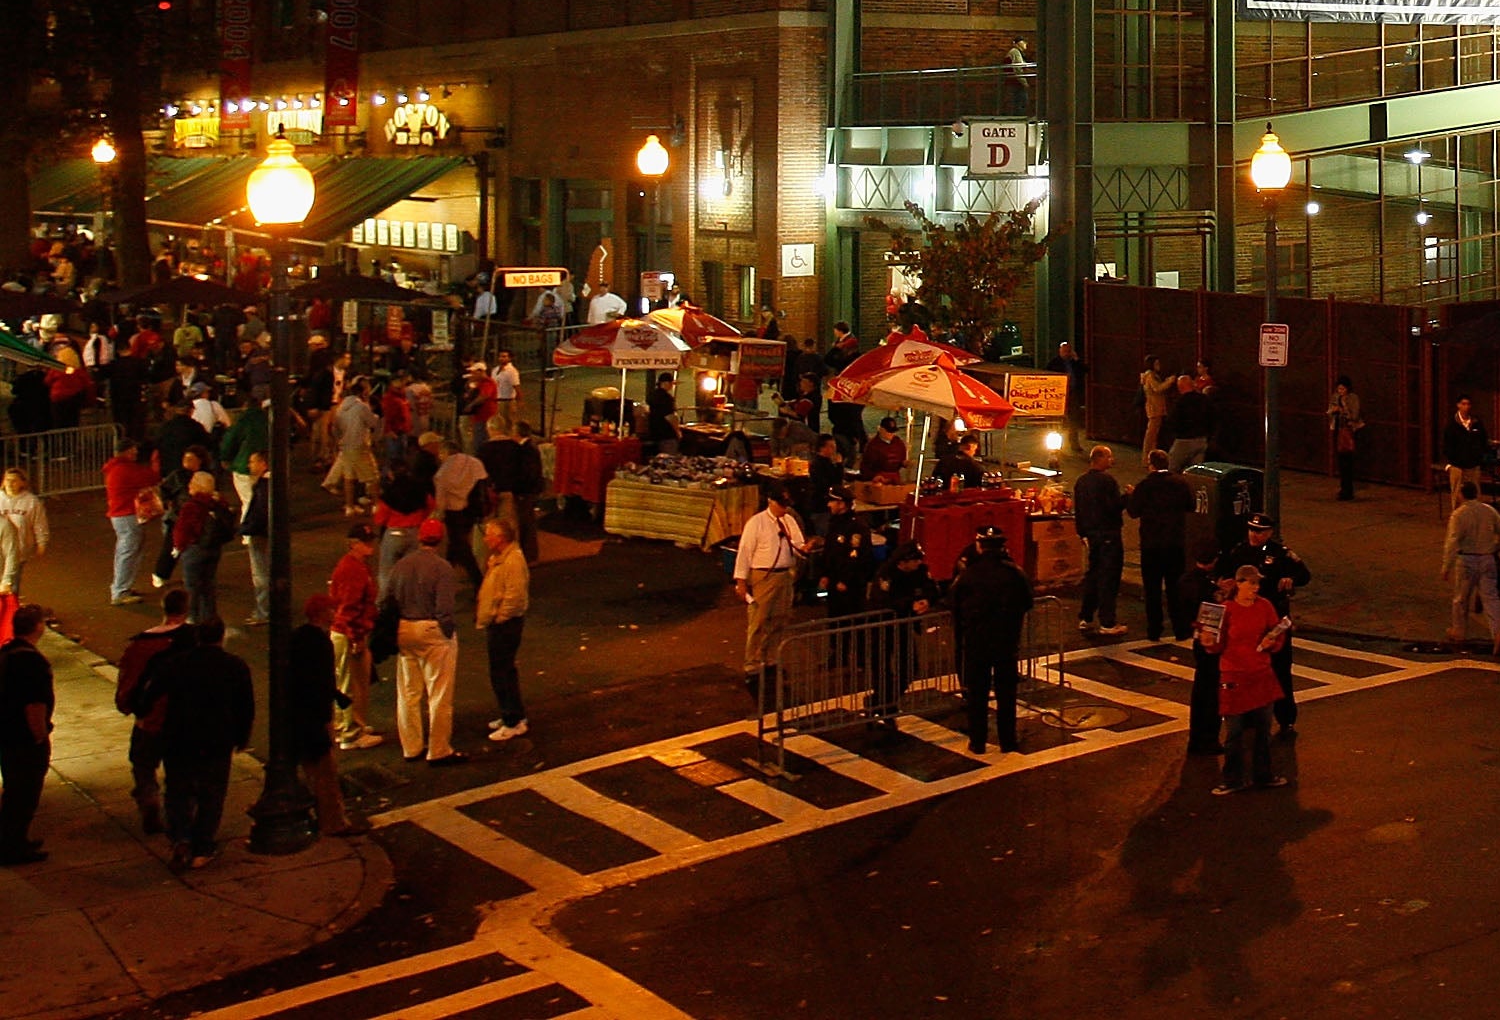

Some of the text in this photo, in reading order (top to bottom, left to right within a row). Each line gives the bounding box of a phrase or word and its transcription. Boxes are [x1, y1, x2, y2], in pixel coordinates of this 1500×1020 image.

[982, 127, 1017, 138] GATE
[987, 143, 1011, 168] D
[512, 274, 553, 285] NO BAGS
[615, 358, 651, 366] FENWAY
